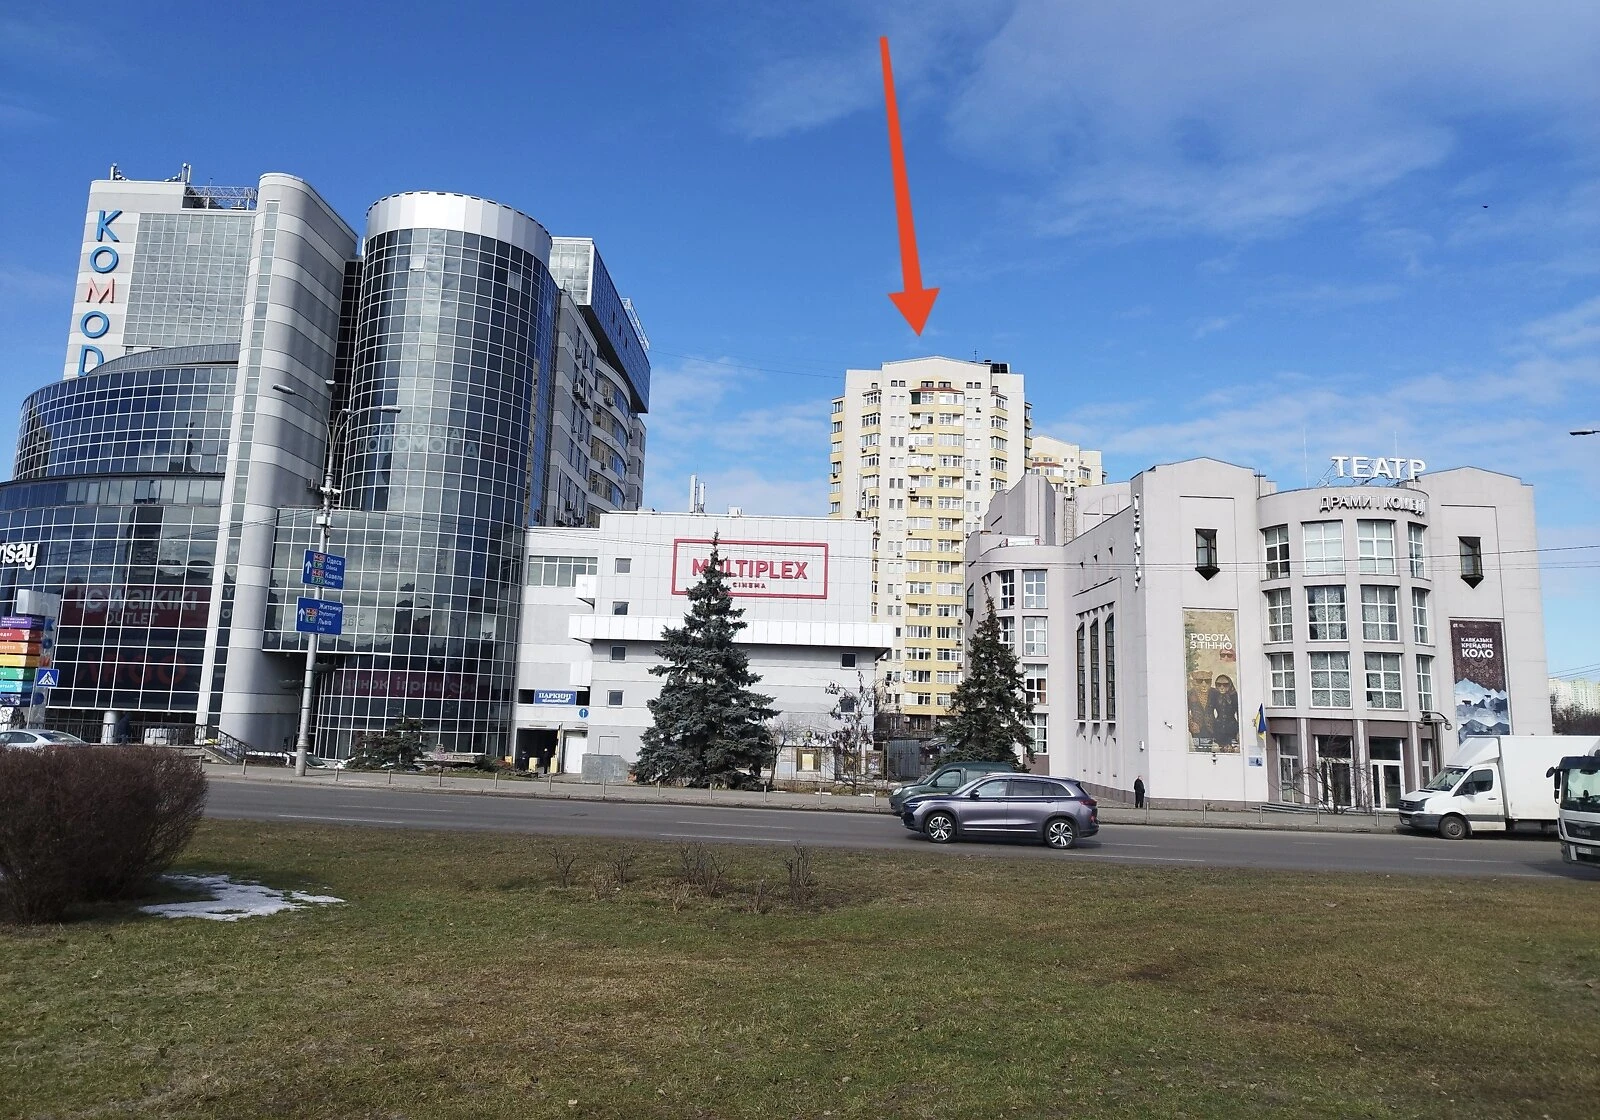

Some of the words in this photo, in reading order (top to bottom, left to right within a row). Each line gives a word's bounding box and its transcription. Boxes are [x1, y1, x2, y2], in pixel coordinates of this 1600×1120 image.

[78, 210, 122, 377] KOMOD
[1331, 456, 1426, 480] ТЕАТР
[1320, 495, 1372, 511] ДРАМИ
[692, 558, 808, 580] MLTIPLEX
[319, 603, 342, 612] Житомир
[104, 612, 159, 625] OUTLET
[1190, 633, 1231, 642] РОБОТА
[1198, 641, 1233, 650] ТІННЮ
[1462, 648, 1494, 658] КОЛО
